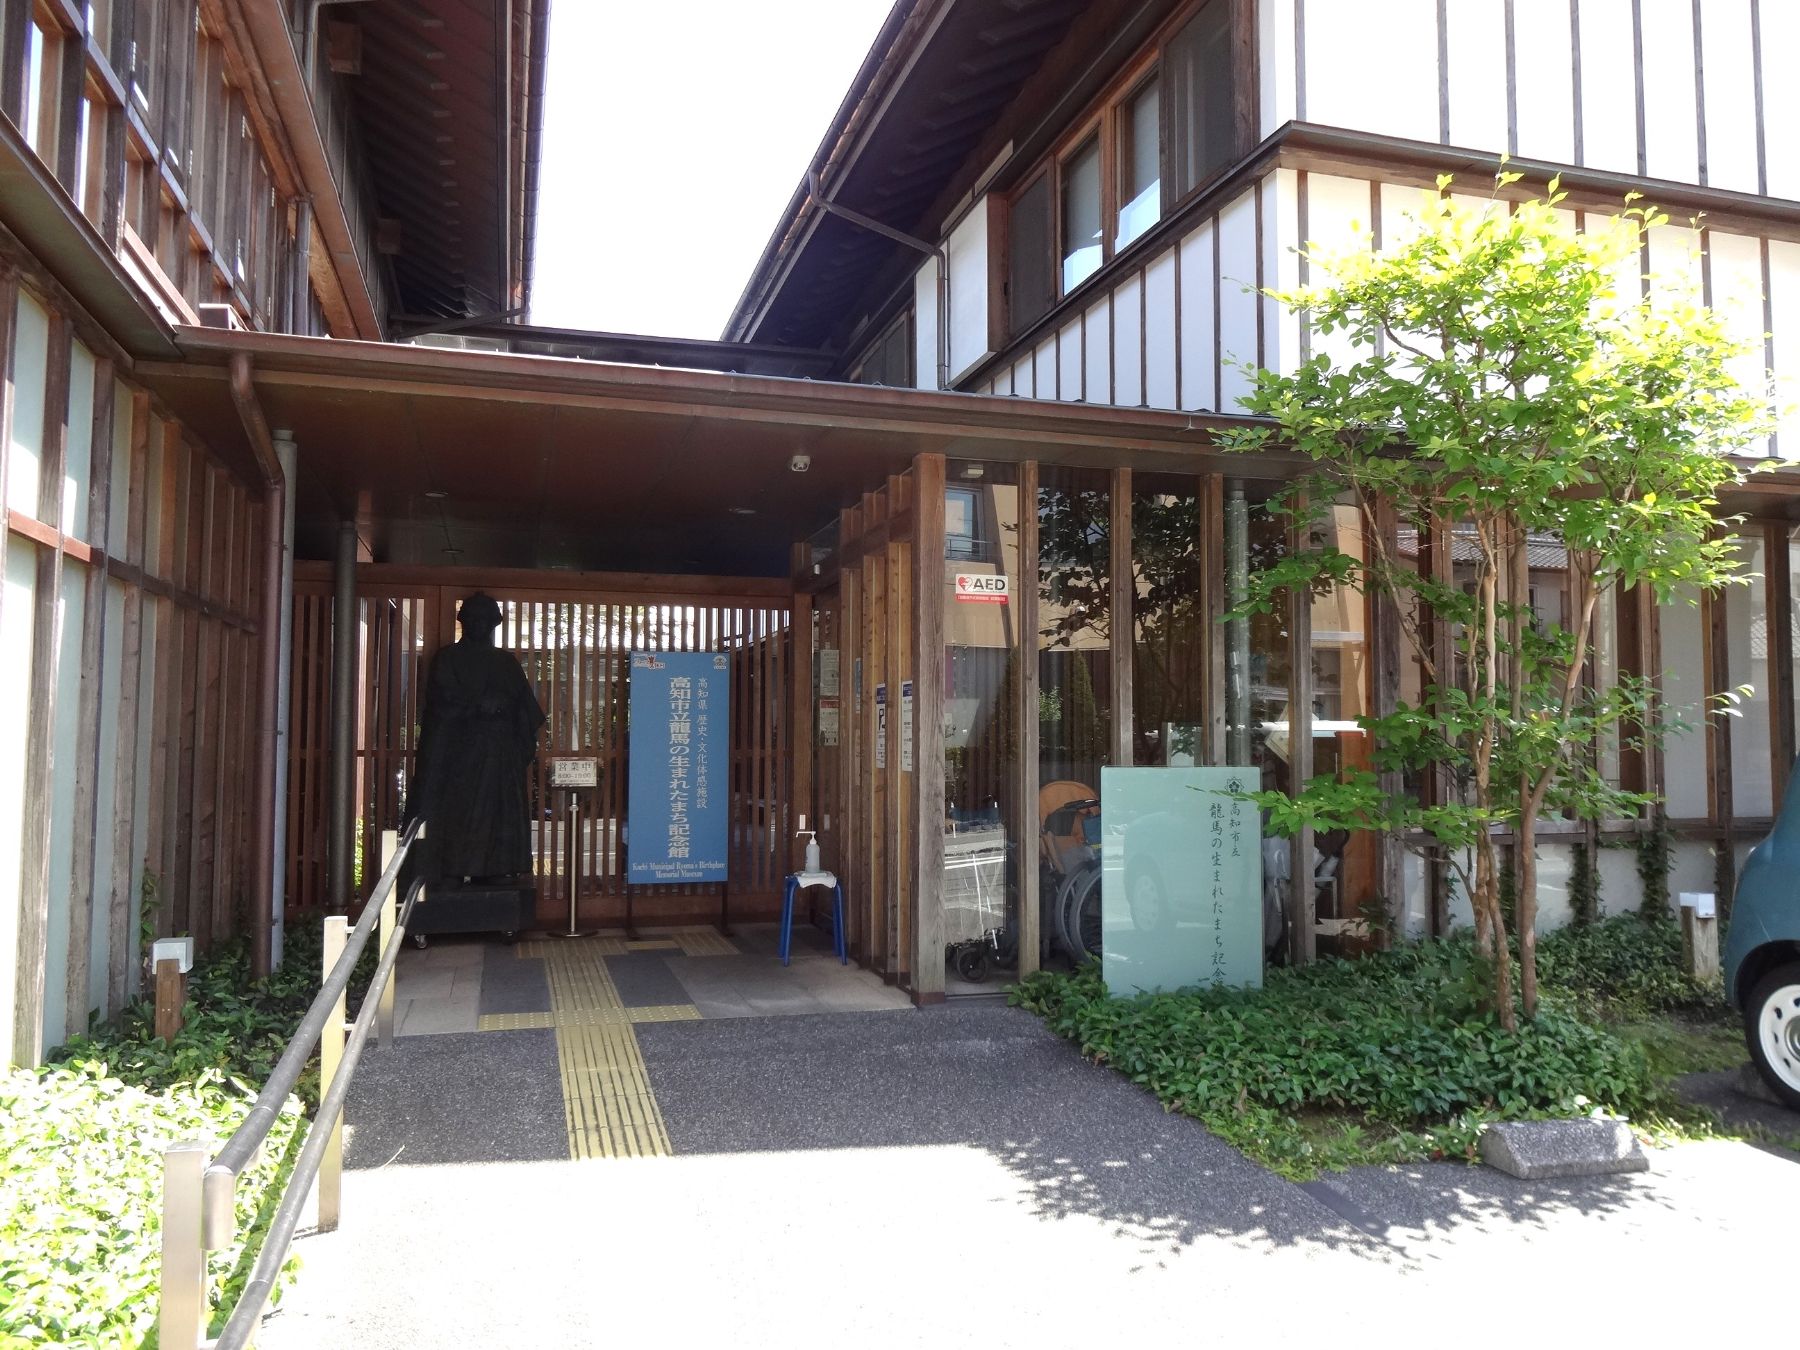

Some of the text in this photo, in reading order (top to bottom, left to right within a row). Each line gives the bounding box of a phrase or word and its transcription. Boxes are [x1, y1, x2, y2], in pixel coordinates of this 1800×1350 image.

[973, 578, 1006, 591] AED
[667, 676, 691, 858] 高知市立龍馬の生まれたまち記念館
[695, 677, 709, 809] 高知県 歴史・文化体感施設
[1228, 803, 1241, 858] 高知市立
